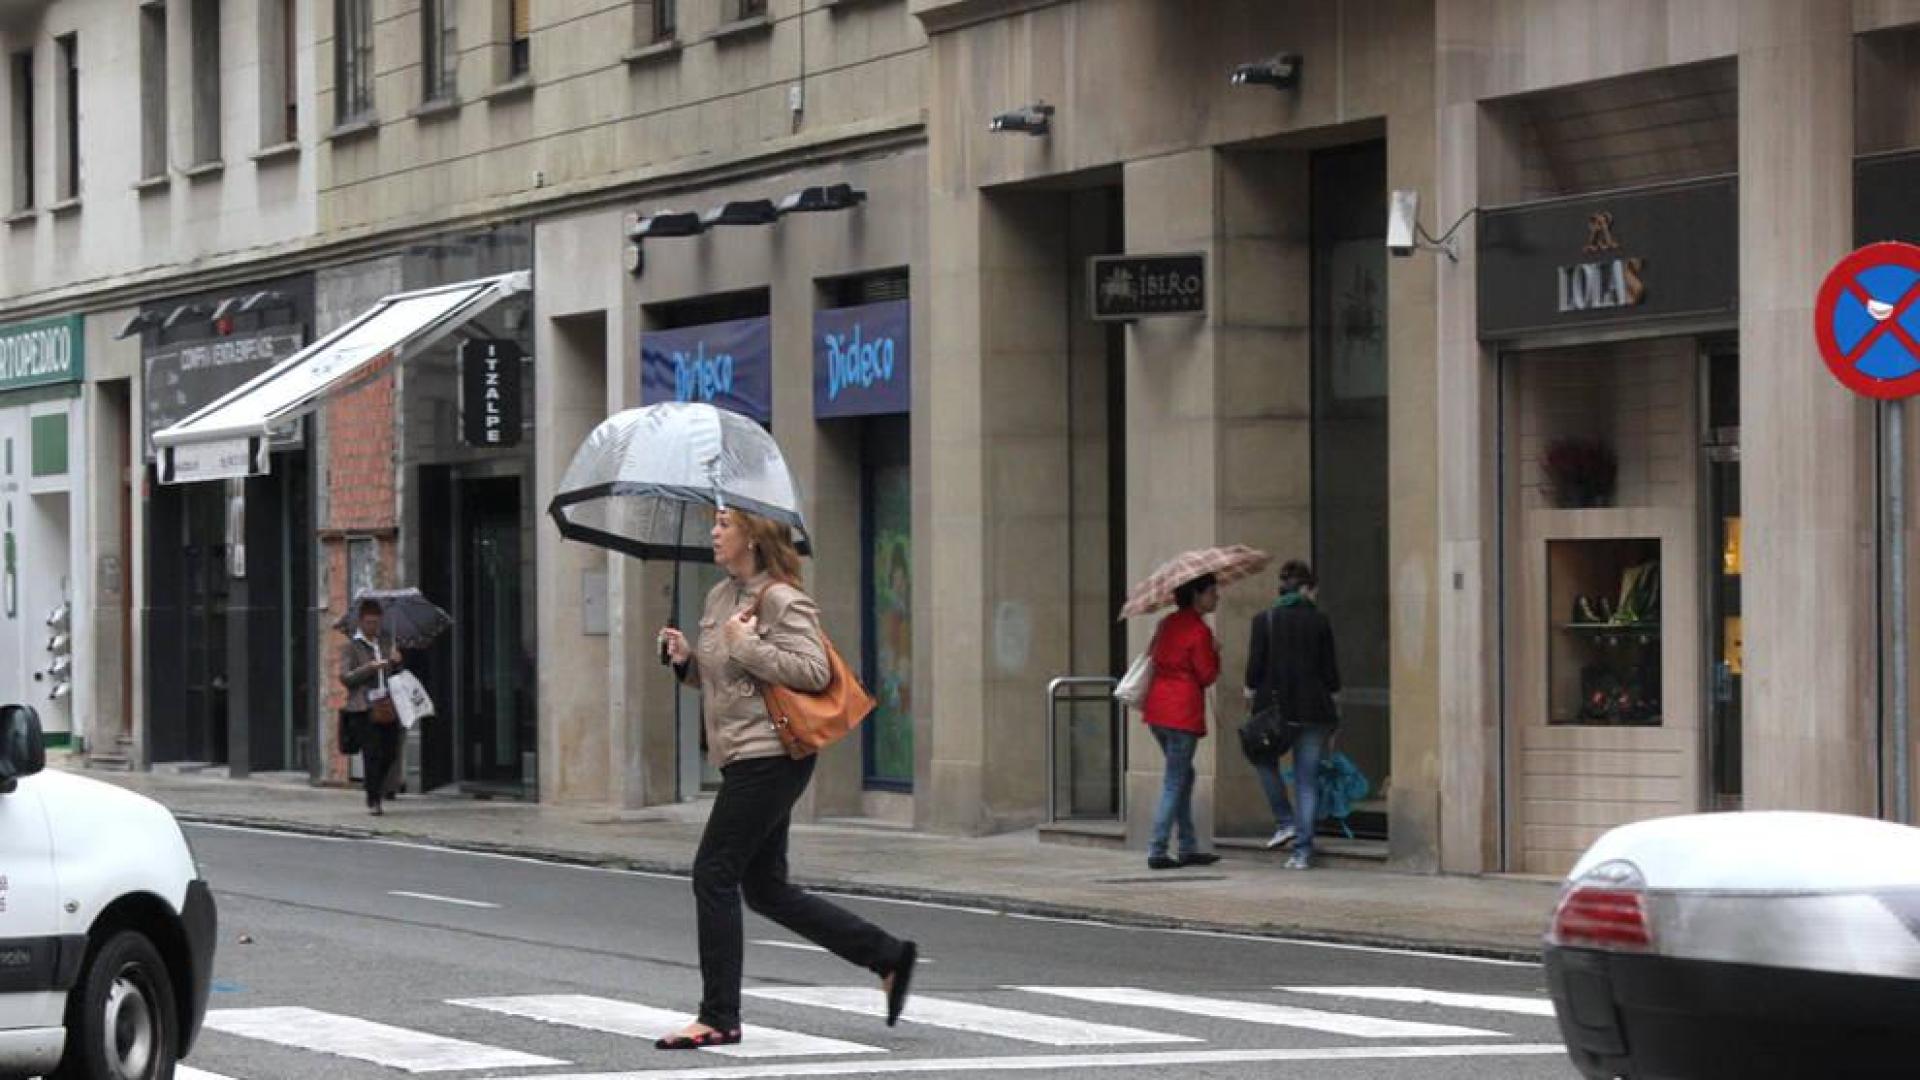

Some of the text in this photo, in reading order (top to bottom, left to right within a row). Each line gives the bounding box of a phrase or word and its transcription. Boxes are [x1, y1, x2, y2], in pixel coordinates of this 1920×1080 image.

[1557, 257, 1647, 312] LOLAS
[485, 344, 500, 442] ITZALPE
[824, 324, 895, 400] Dideco
